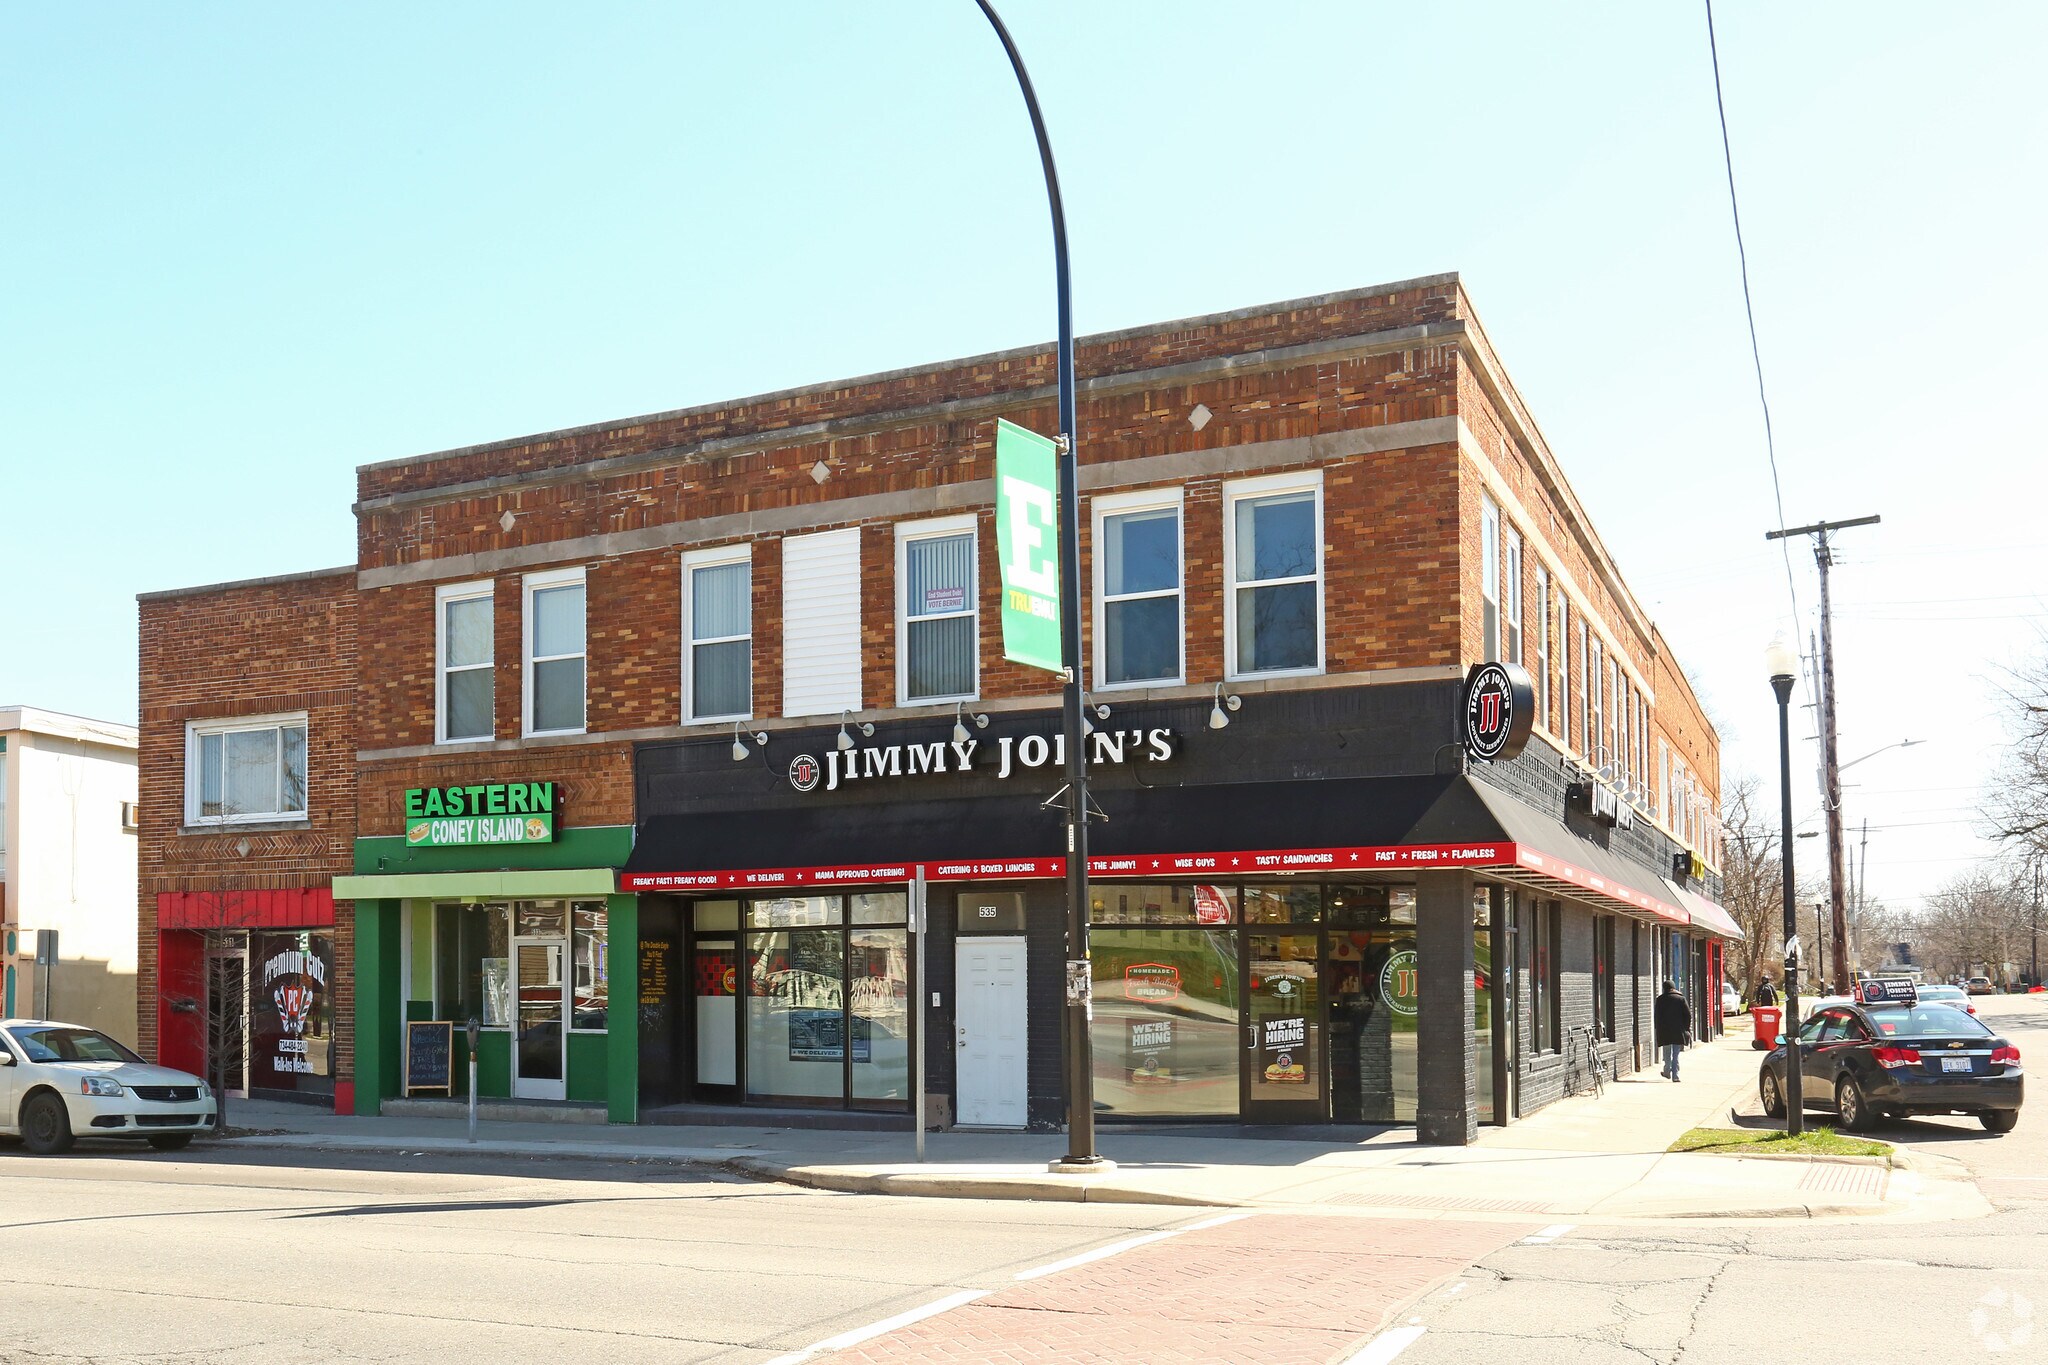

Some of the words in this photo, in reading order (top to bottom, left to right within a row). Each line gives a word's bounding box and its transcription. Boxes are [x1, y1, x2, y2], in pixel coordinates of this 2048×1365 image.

[1003, 475, 1057, 599] E
[927, 591, 936, 599] End
[936, 590, 952, 598] Student
[952, 589, 963, 597] Debt
[928, 600, 942, 608] VOTE
[942, 598, 962, 607] BERNIE
[1470, 673, 1490, 713] JIMMY
[1491, 672, 1510, 710] JOHN'S
[1480, 692, 1501, 734] JJ
[825, 739, 979, 790] JIMMY
[405, 782, 552, 817] EASTERN
[431, 819, 475, 844] CONEY
[478, 817, 524, 842] ISLAND
[1255, 855, 1280, 865] TASTY
[1283, 853, 1333, 864] SANDWICHES
[1375, 851, 1396, 861] FAST
[1411, 849, 1438, 860] FRESH
[1451, 848, 1495, 859] FLAWLESS
[938, 865, 971, 875] CATERING
[973, 865, 978, 873] &
[980, 864, 1003, 873] BOXED
[1005, 863, 1035, 873] LUNCHES
[1093, 861, 1107, 870] THE
[1109, 860, 1136, 870] JIMMY!
[1175, 858, 1193, 868] WISE
[1195, 858, 1216, 867] GUYS
[746, 874, 756, 882] WE
[757, 873, 784, 882] DELIVER!
[815, 871, 835, 880] MAMA
[836, 869, 869, 879] APPROVED
[871, 868, 905, 877] CATERING!
[633, 877, 655, 886] FREAKY
[656, 876, 673, 885] FAST!
[674, 876, 696, 885] FREAKY
[697, 875, 717, 884] GOOD!
[980, 907, 996, 917] 535
[264, 948, 304, 987] Premium
[306, 950, 325, 987] Cutz
[1384, 955, 1407, 984] JIMMY
[1136, 988, 1167, 996] BREAD
[288, 989, 298, 1012] PC
[1132, 1021, 1171, 1034] WE'RE
[1265, 1017, 1304, 1031] WE'RE
[1132, 1031, 1171, 1047] HIRING
[1265, 1028, 1304, 1043] HIRING
[293, 1057, 313, 1073] Welcome
